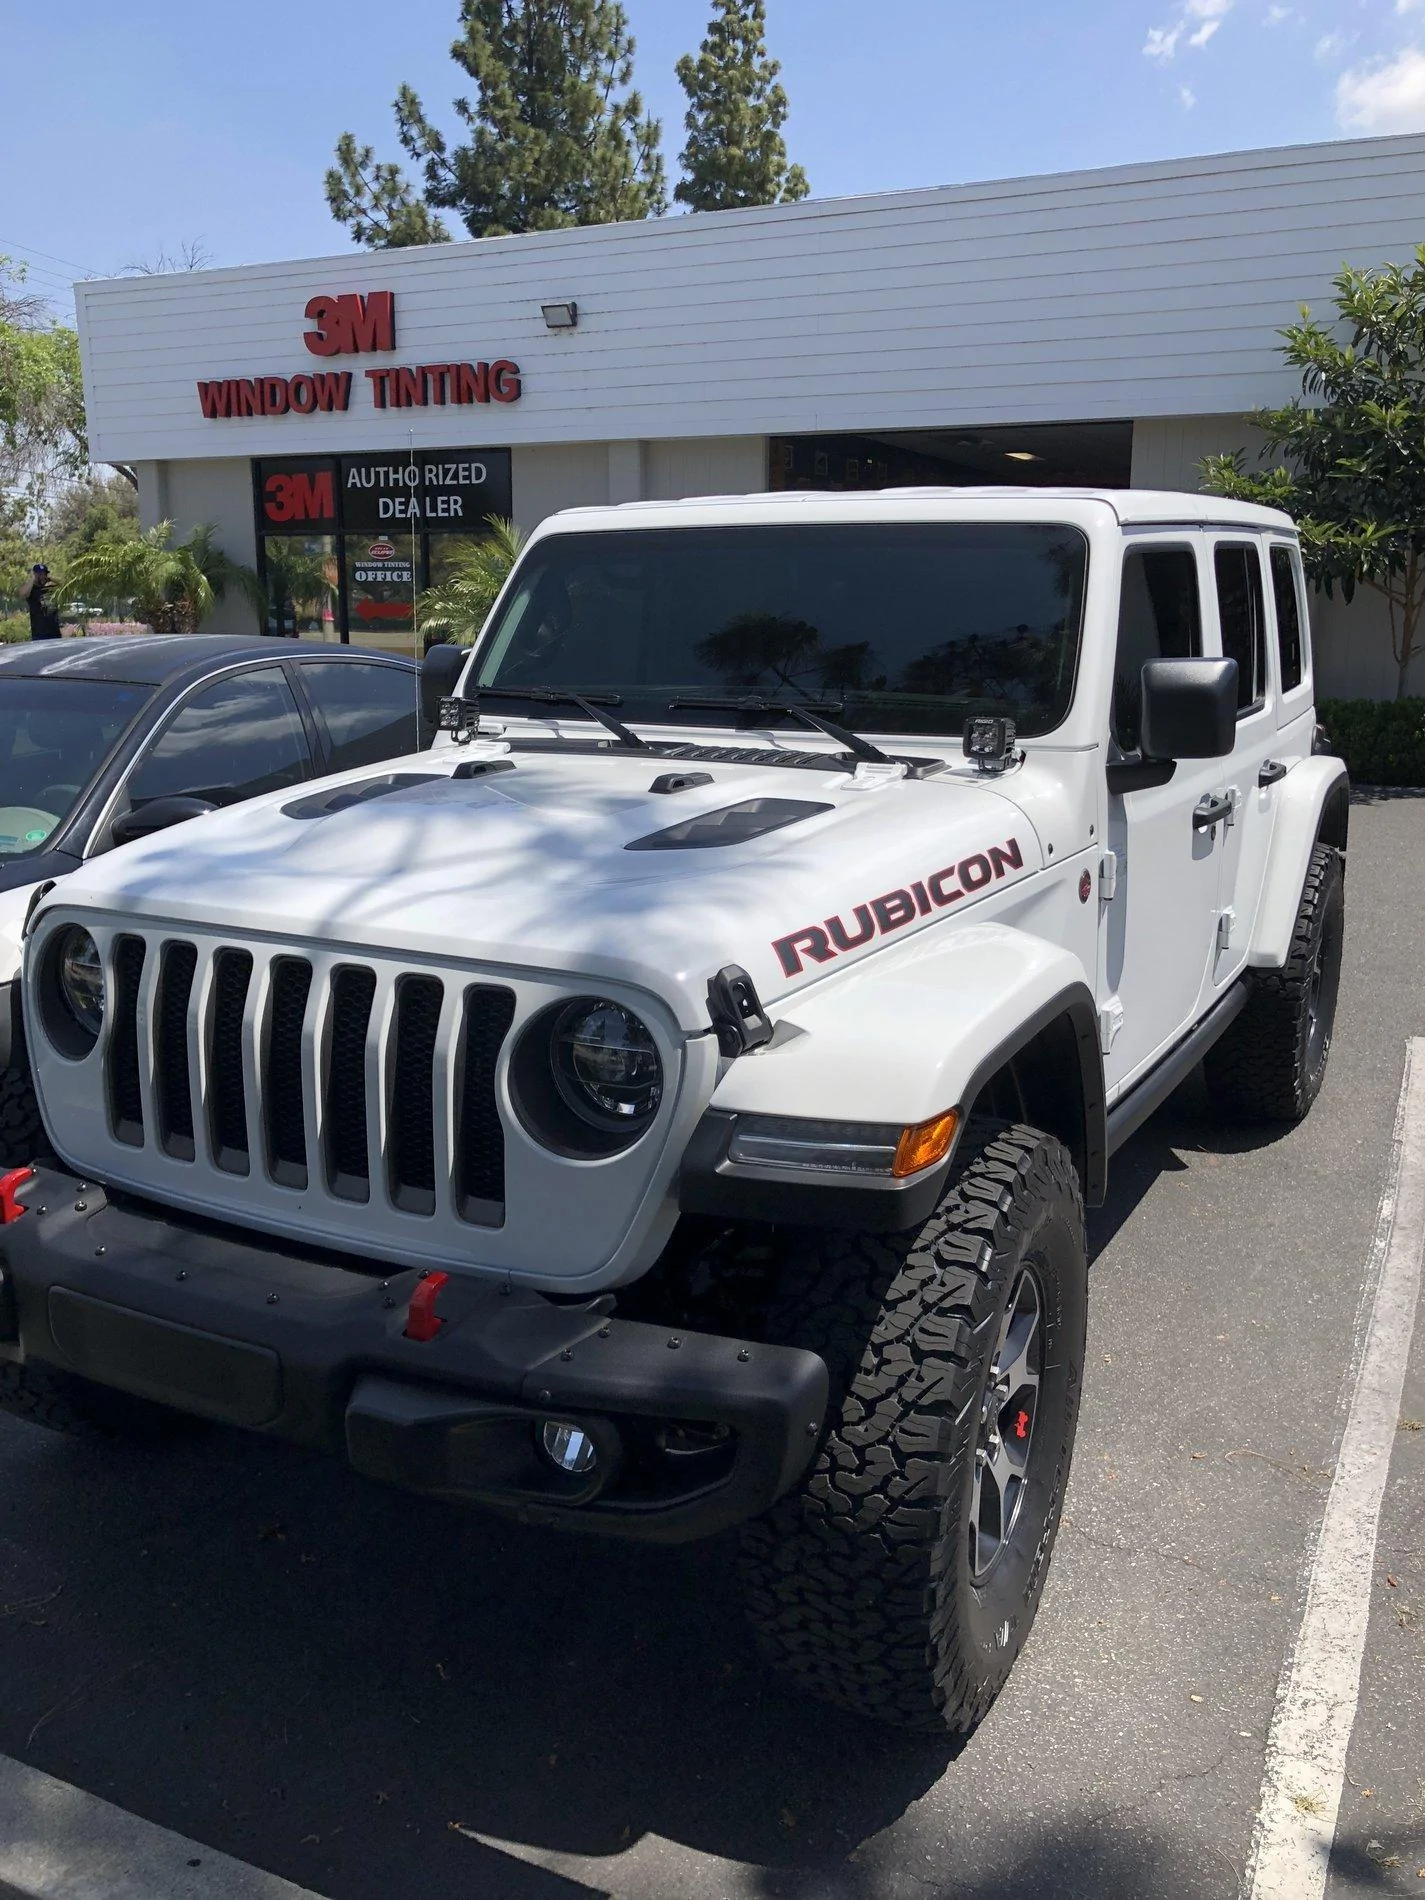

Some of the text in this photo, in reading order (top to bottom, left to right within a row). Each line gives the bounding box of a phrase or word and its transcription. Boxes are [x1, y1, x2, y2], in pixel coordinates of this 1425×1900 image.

[304, 291, 396, 357] 3M
[197, 360, 522, 418] WINDOW TINTING
[265, 471, 335, 521] 3M
[355, 570, 412, 581] OFFICE
[771, 837, 1024, 979] RUBICON
